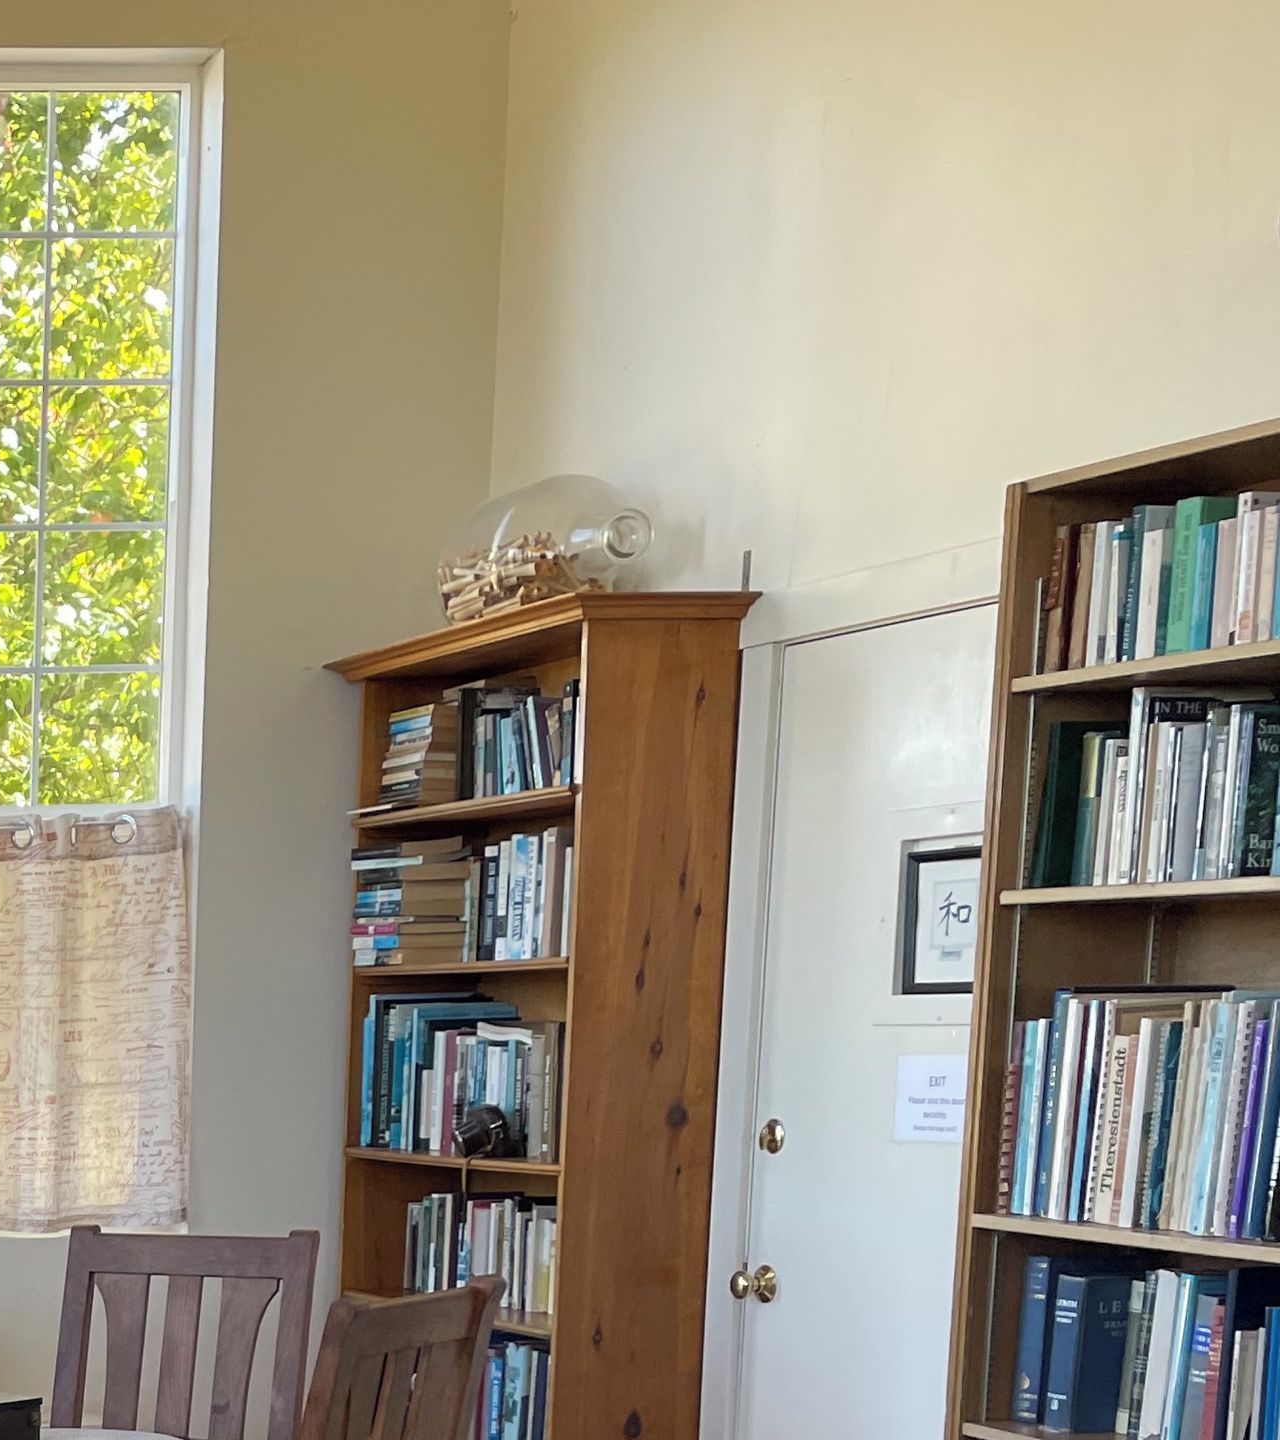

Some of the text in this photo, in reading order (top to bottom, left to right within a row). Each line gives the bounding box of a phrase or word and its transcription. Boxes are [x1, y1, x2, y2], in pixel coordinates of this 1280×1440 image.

[936, 891, 972, 936] 和
[929, 1075, 946, 1087] EXIT
[1100, 1047, 1127, 1193] Theresienstadt
